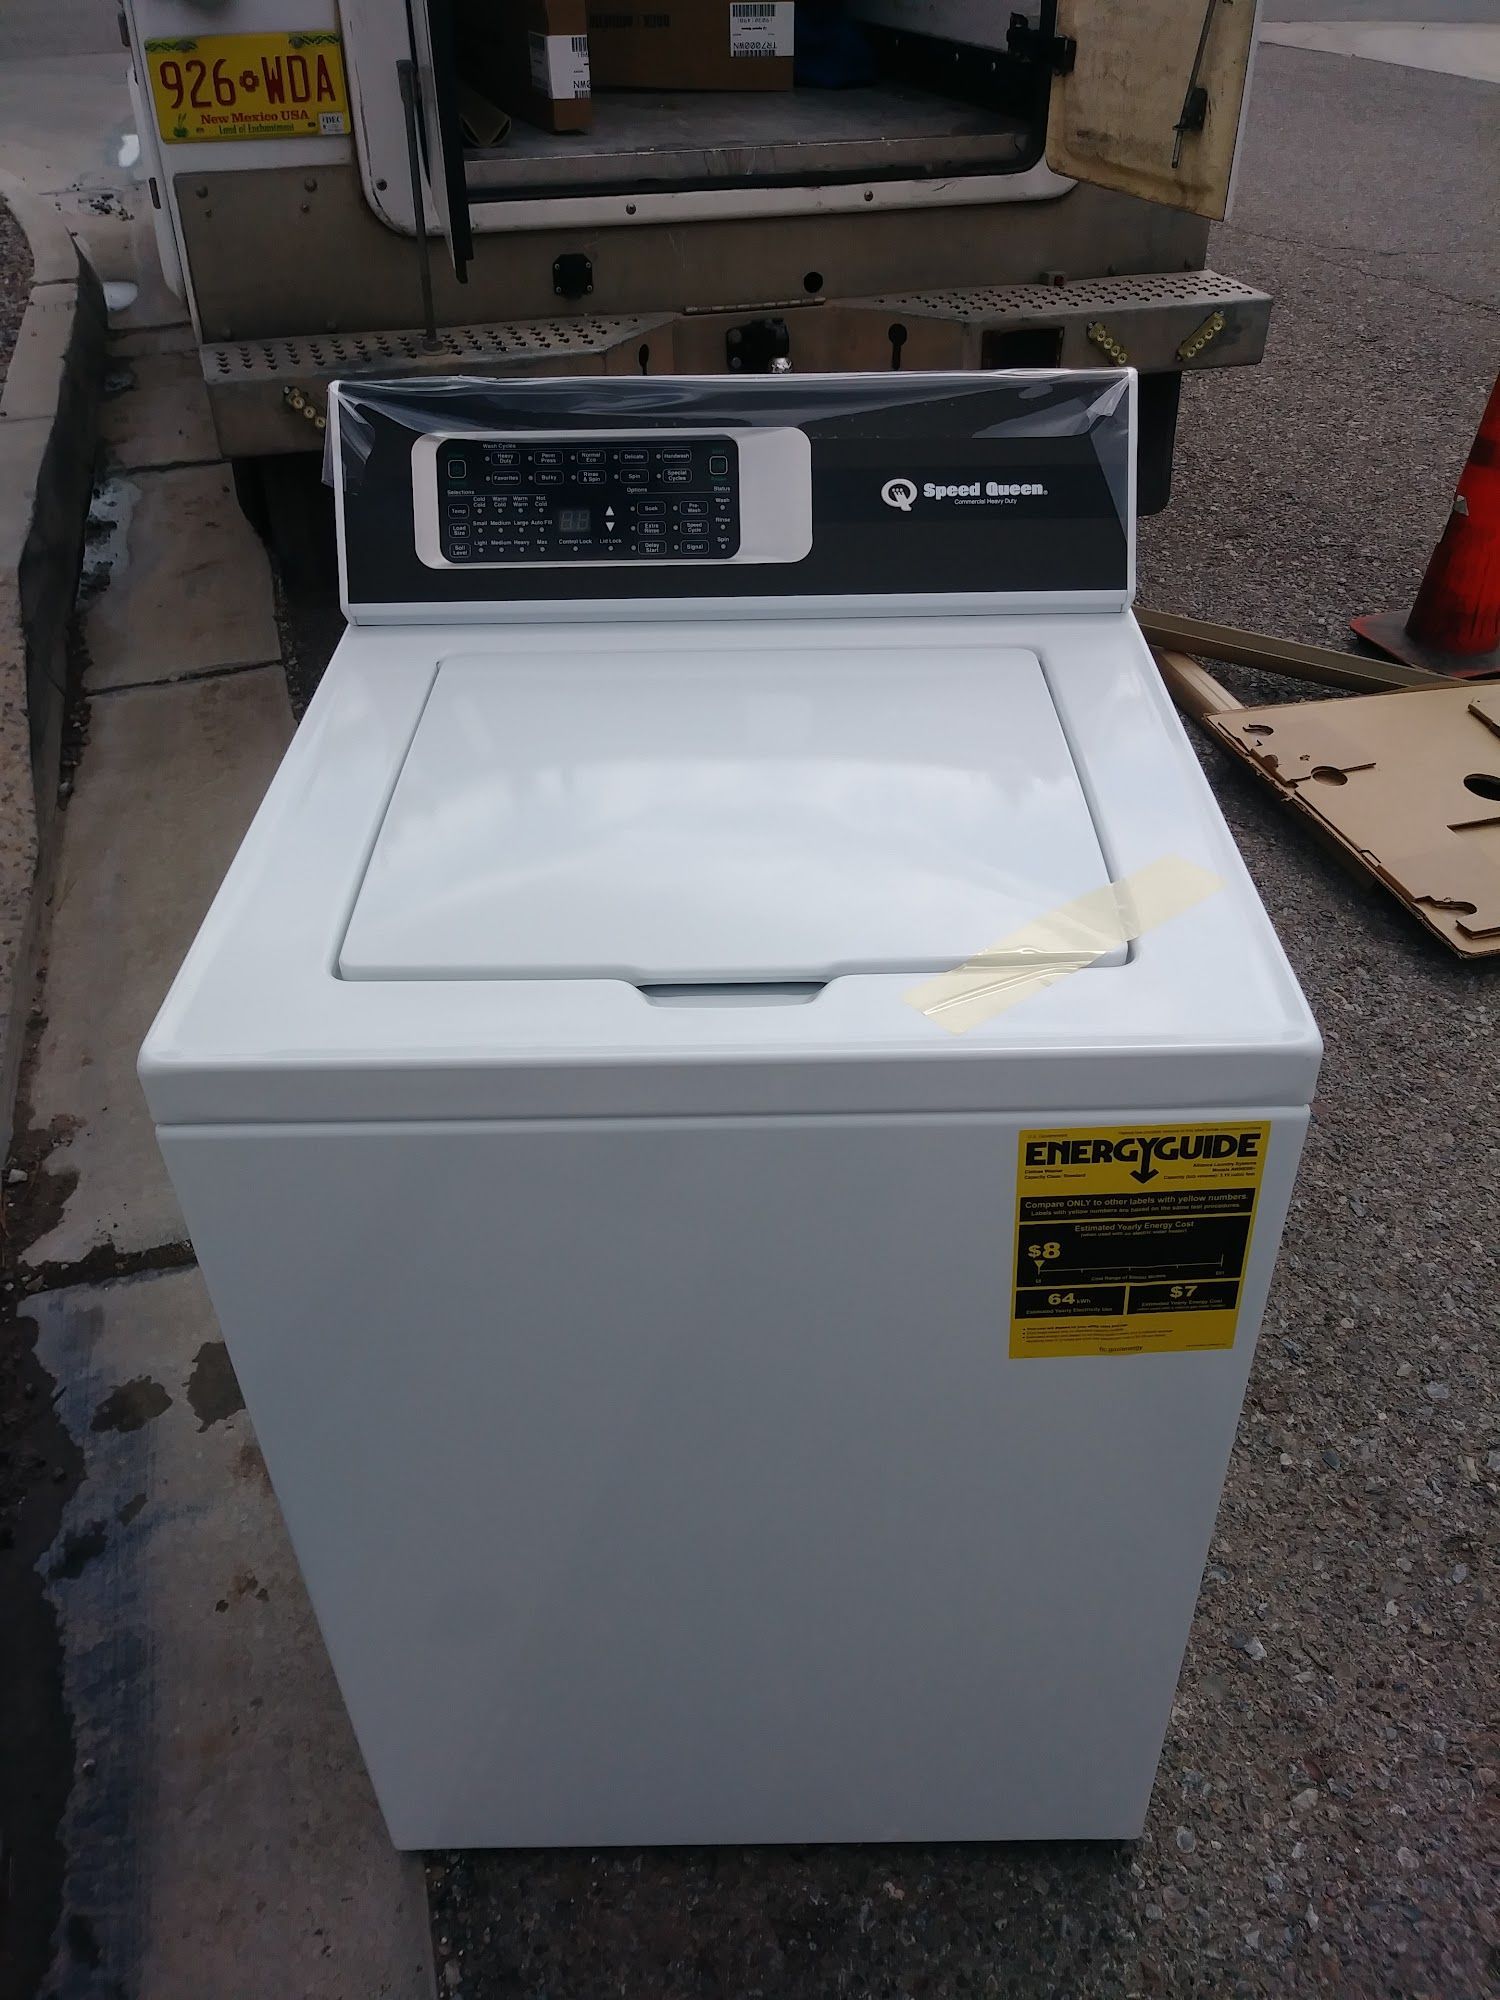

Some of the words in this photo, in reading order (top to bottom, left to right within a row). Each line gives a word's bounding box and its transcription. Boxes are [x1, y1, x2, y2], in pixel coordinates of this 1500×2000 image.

[159, 59, 236, 109] 926
[261, 55, 336, 105] WDA
[201, 114, 229, 125] New
[232, 112, 278, 123] Mexico
[280, 110, 310, 121] USA
[923, 482, 981, 500] Speed
[1004, 497, 1018, 505] Duty
[1025, 1133, 1262, 1168] ENERGYGUIDE
[1025, 1201, 1065, 1209] Compare
[1067, 1199, 1091, 1207] ONLY
[1104, 1198, 1128, 1206] other
[1130, 1197, 1155, 1205] labels
[1178, 1195, 1207, 1204] yellow
[1074, 1224, 1115, 1232] Estimated
[1117, 1223, 1143, 1231] Yearly
[1144, 1222, 1173, 1230] Energy
[1028, 1242, 1062, 1259] $8
[1048, 1293, 1076, 1305] 64
[1169, 1285, 1198, 1299] $7
